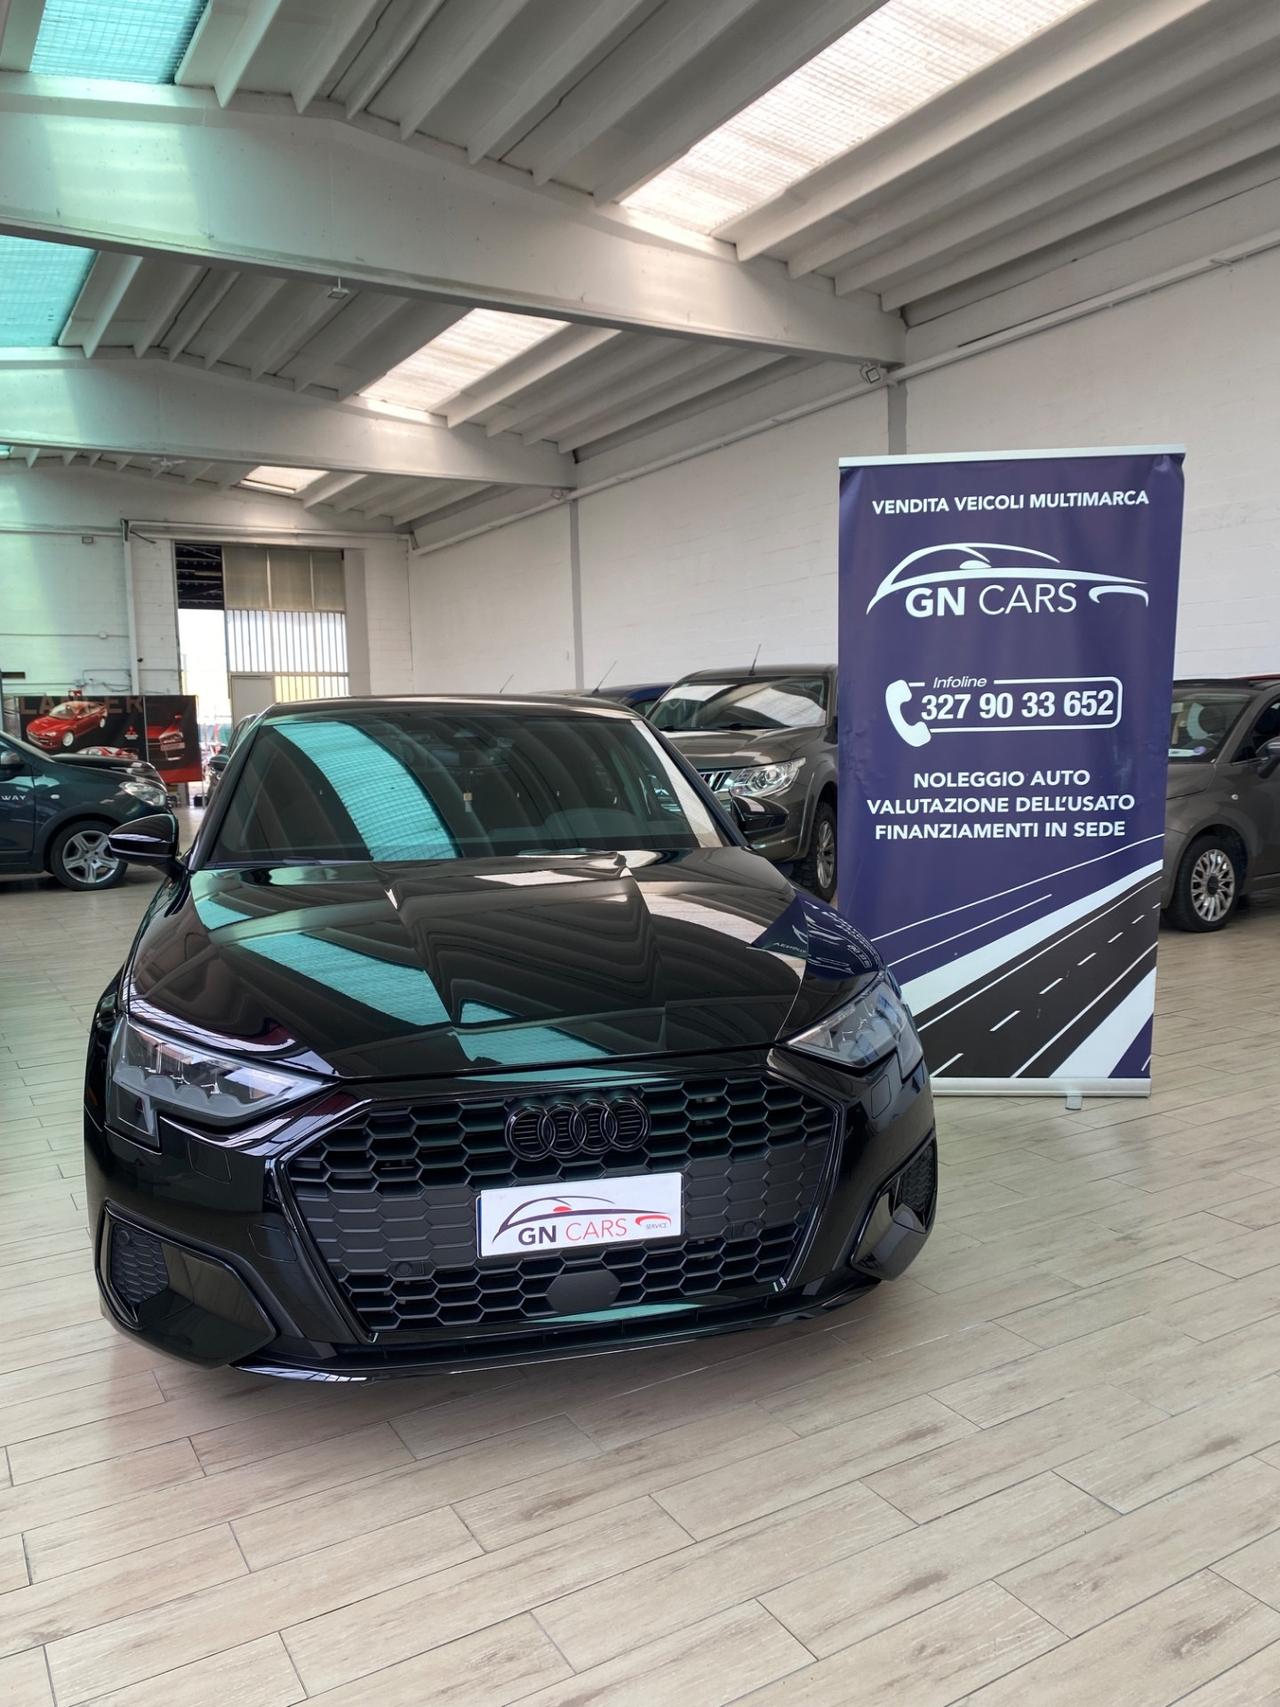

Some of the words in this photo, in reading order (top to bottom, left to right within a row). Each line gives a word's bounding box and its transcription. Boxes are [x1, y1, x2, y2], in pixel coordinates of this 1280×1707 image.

[872, 496, 950, 515] VENDITA
[954, 494, 1025, 512] VEICOLI
[1029, 490, 1150, 509] MULTIMARCA
[905, 585, 966, 618] GN
[978, 582, 1078, 616] CARS
[932, 676, 988, 689] Infoline
[21, 694, 144, 714] LAER
[920, 693, 972, 721] 327
[979, 692, 1014, 719] 90
[1021, 691, 1056, 718] 33
[1063, 689, 1115, 717] 652
[913, 771, 1025, 789] NOLEGGIO
[1029, 769, 1091, 786] AUTO
[866, 797, 1010, 815] VALUTAZIONE
[875, 823, 1039, 840] FINANZIAMENTI
[1044, 822, 1067, 839] IN
[1073, 820, 1126, 838] SEDE
[517, 1225, 557, 1246] GN
[565, 1218, 627, 1241] CARS
